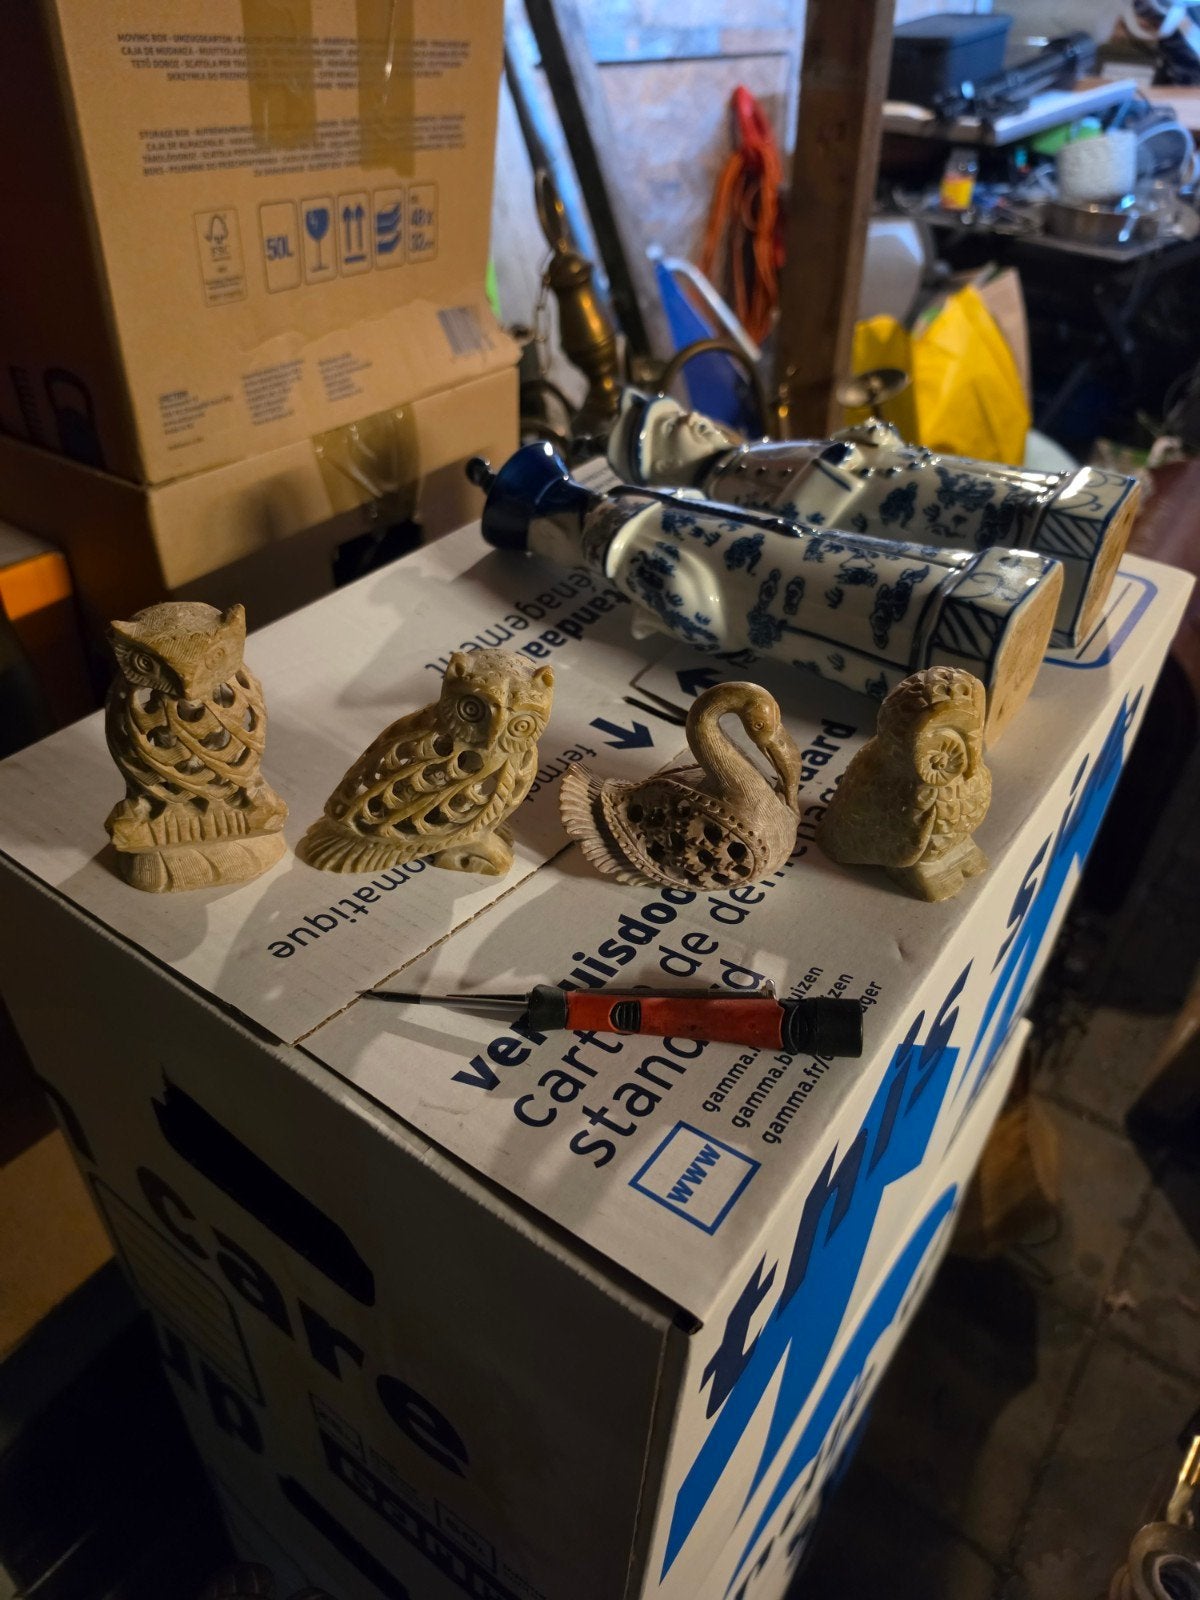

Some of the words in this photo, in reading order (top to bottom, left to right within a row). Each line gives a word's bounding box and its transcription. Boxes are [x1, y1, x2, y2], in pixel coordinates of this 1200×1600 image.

[268, 858, 426, 958] omatique
[659, 932, 719, 978] de
[666, 1143, 721, 1204] www
[699, 957, 975, 1420] this
[136, 1166, 470, 1479] care
